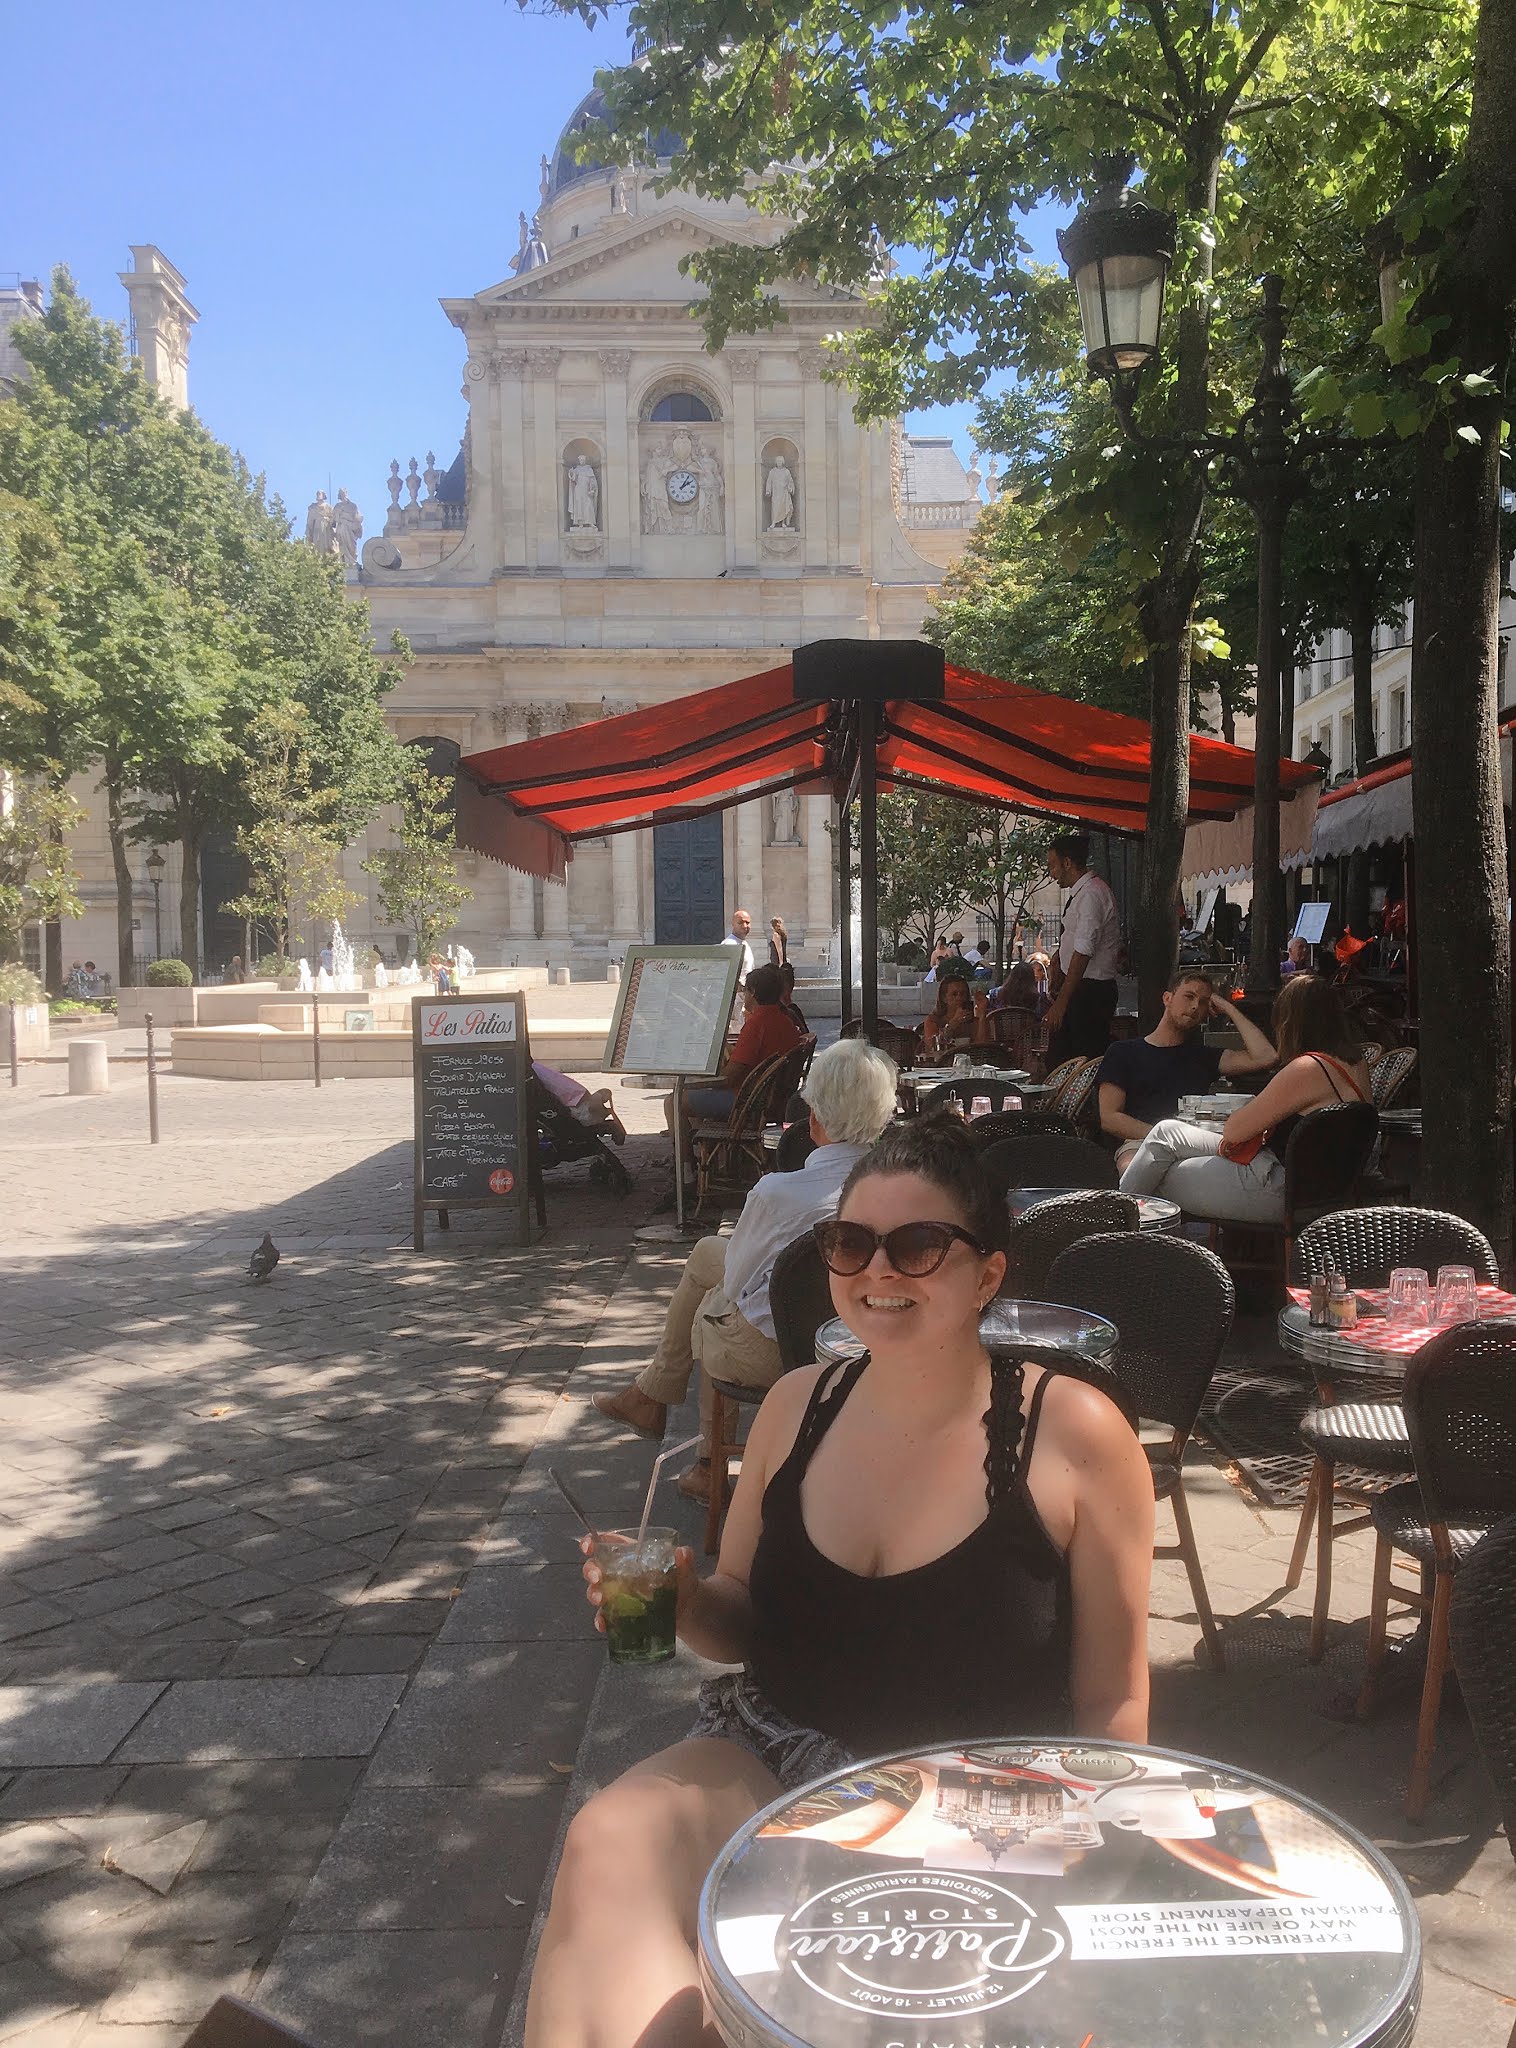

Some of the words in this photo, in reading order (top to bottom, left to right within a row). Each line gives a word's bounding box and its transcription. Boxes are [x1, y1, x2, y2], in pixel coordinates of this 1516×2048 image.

[425, 1011, 457, 1037] Les
[460, 1010, 512, 1036] Patios
[830, 1877, 917, 1904] PARISIENNES
[922, 1876, 993, 1901] HISTOIRES
[831, 1907, 998, 1924] STORIES
[1159, 1906, 1292, 1920] DEPARTMENT
[1300, 1905, 1400, 1916] PARISIAN
[1090, 1911, 1150, 1923] STORE
[1153, 1924, 1190, 1934] THE
[1197, 1922, 1218, 1932] IN
[1225, 1921, 1264, 1932] LIFE
[1271, 1920, 1299, 1930] OF
[1309, 1919, 1356, 1929] WAY
[1090, 1925, 1145, 1936] MOST
[1092, 1938, 1174, 1950] FRENCH
[1182, 1936, 1218, 1947] THE
[1225, 1932, 1353, 1946] EXPERIENCE
[787, 1918, 1065, 1972] Parisian
[986, 1983, 1004, 1994] 12
[895, 1998, 912, 2007] 18
[927, 1989, 986, 2007] JUILLET
